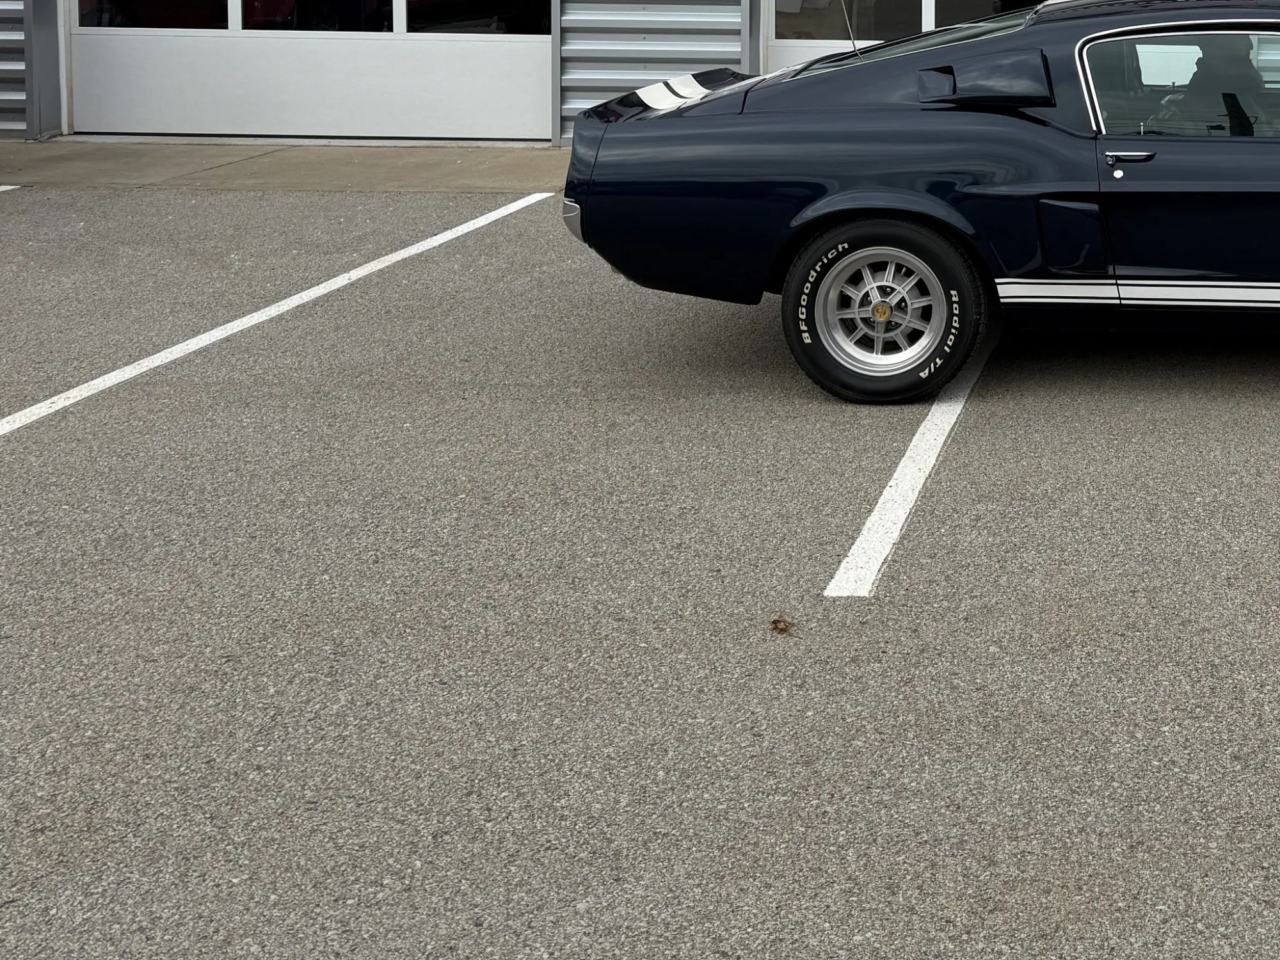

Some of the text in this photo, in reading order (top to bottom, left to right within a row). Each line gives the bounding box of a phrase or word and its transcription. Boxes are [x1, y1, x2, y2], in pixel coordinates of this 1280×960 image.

[798, 242, 849, 344] BFGoodrich
[918, 290, 960, 379] Radial T/A
